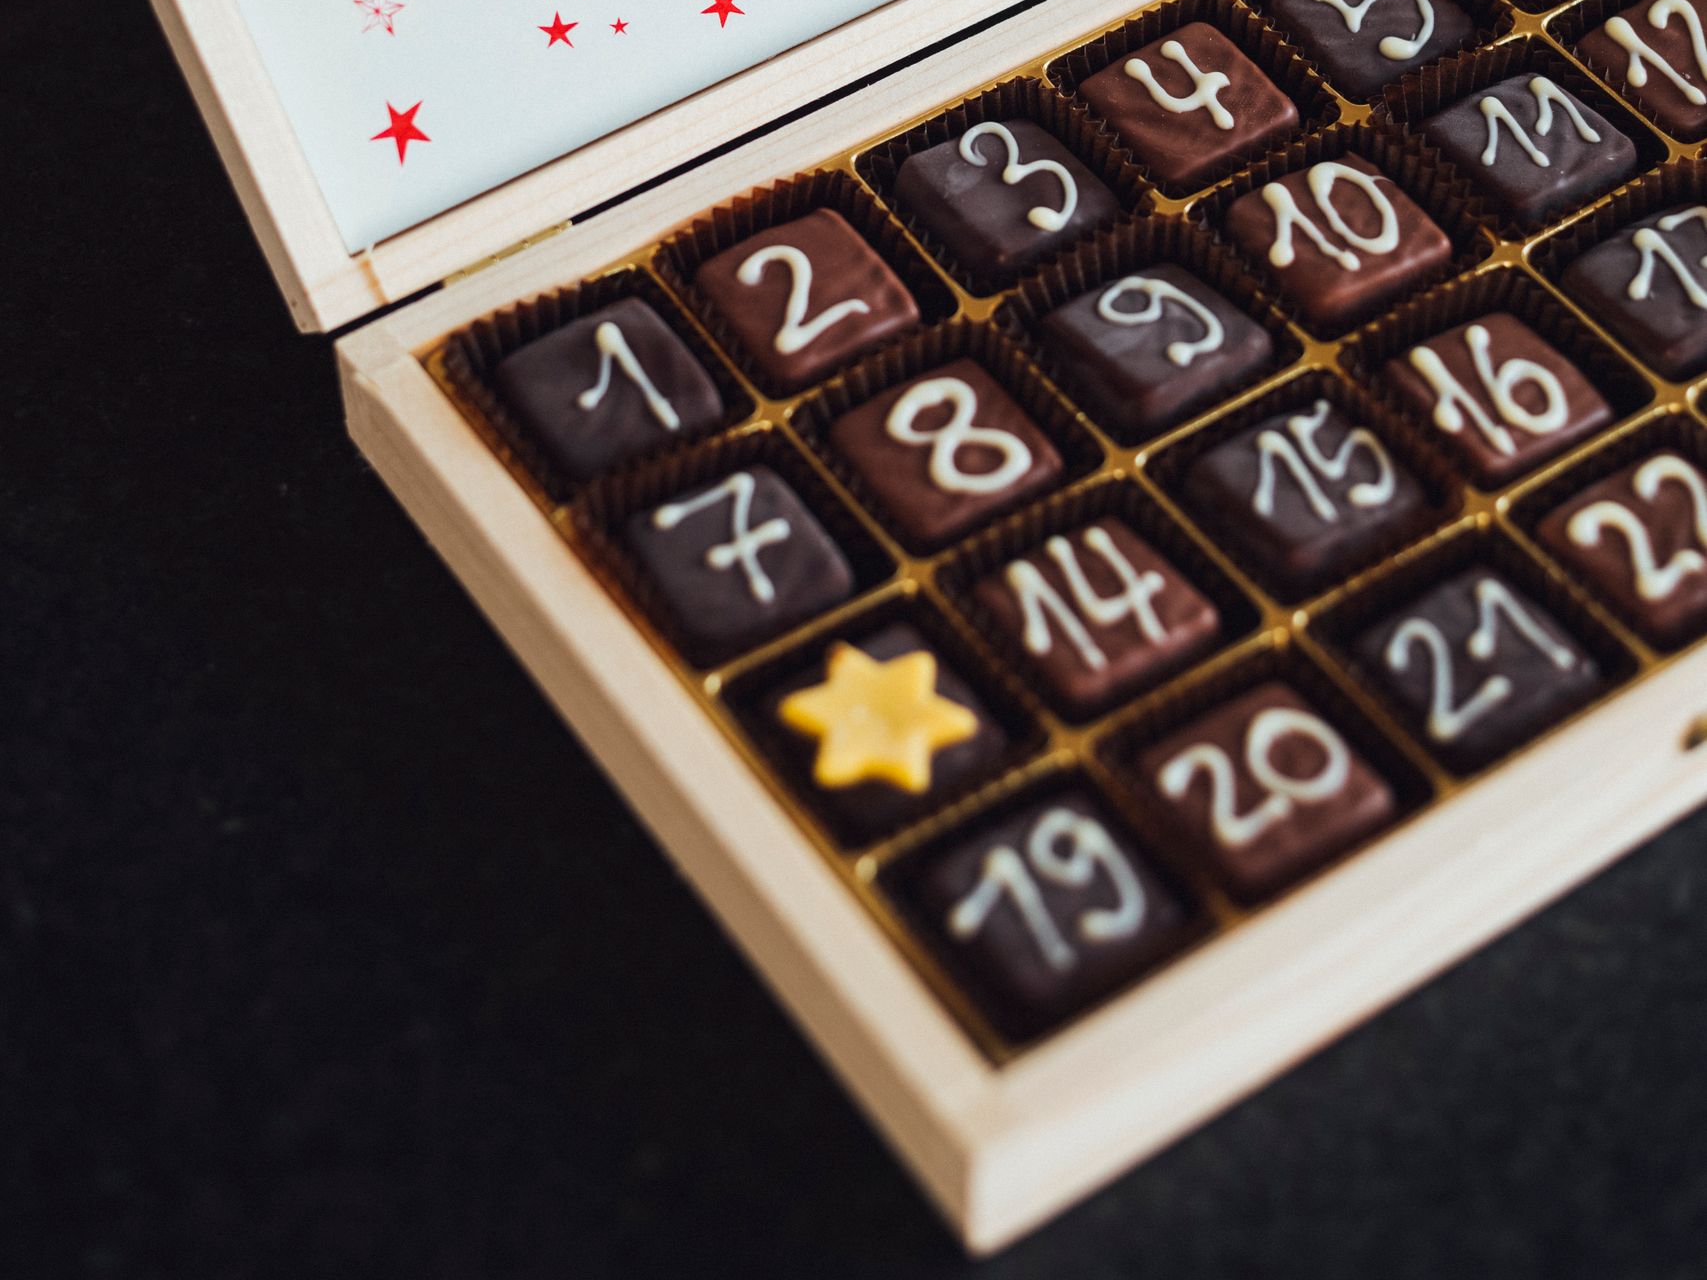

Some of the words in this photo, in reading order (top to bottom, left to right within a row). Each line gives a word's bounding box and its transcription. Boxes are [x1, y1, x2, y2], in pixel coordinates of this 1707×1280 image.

[1124, 40, 1234, 130] 4
[1480, 76, 1601, 167] 11
[959, 121, 1077, 232] 3
[1262, 161, 1399, 271] 10
[737, 244, 869, 355] 2
[1100, 276, 1225, 367] 9
[578, 321, 681, 431] 1
[887, 376, 1032, 494] 8
[1410, 324, 1568, 456] 16
[1253, 399, 1395, 520] 15
[653, 472, 791, 605] 7
[1008, 527, 1169, 671] 14
[1387, 579, 1575, 741] 21
[1159, 707, 1352, 846] 20
[948, 806, 1147, 973] 19
